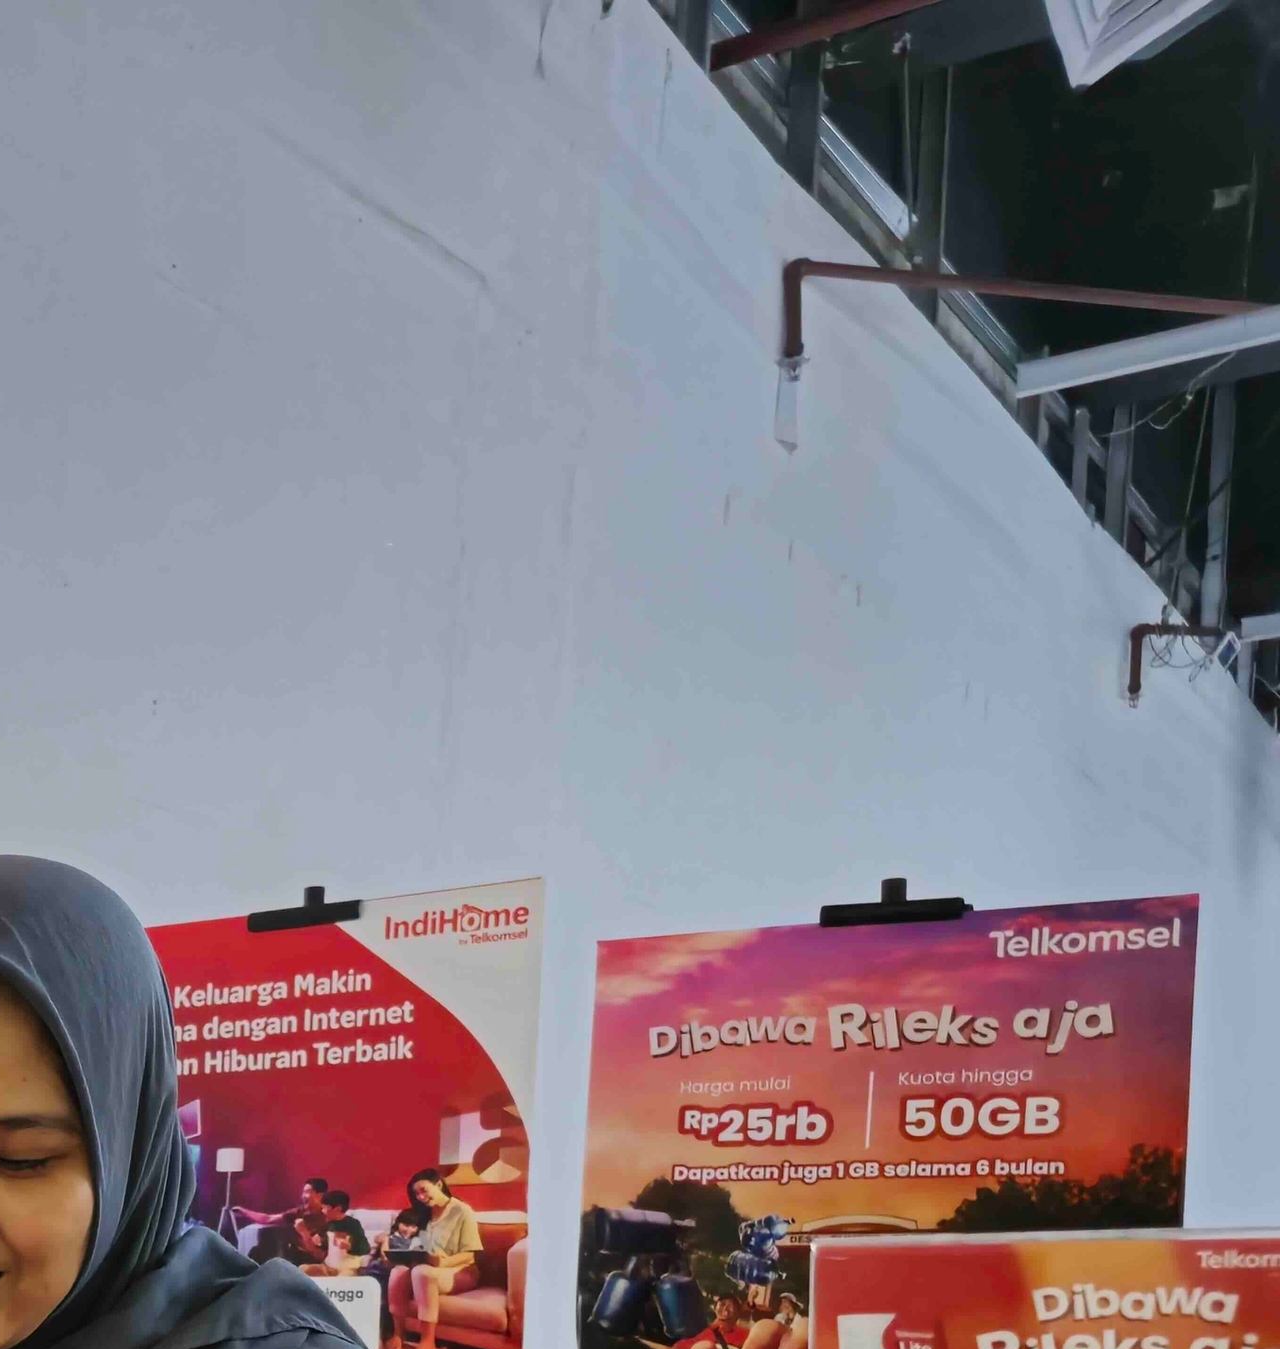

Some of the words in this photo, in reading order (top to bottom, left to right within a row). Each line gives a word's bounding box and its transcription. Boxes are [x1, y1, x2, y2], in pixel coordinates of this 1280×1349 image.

[385, 905, 529, 939] IndiHome
[470, 929, 528, 945] Telkomsel
[989, 919, 1181, 958] Telkomsel
[174, 979, 288, 1009] Keluarga
[294, 970, 371, 997] Makin
[204, 1015, 297, 1039] dengan
[304, 1000, 414, 1031] Internet
[649, 1011, 815, 1057] Dibawa
[828, 1002, 999, 1050] Rileks
[1013, 1000, 1114, 1052] aja
[205, 1049, 306, 1073] Hiburan
[313, 1036, 413, 1066] Terbaik
[680, 1081, 733, 1096] Harga
[739, 1076, 791, 1092] mulai
[898, 1069, 955, 1085] Kuota
[961, 1068, 1032, 1084] hingga
[684, 1107, 827, 1142] Rp25rb
[904, 1098, 1061, 1135] 50GB
[674, 1165, 779, 1183] Dapatkan
[781, 1164, 833, 1181] juga
[836, 1164, 845, 1178] 1
[848, 1162, 879, 1178] GB
[884, 1161, 973, 1178] selama
[977, 1160, 990, 1177] 6
[993, 1158, 1064, 1177] bulan
[1033, 1284, 1239, 1326] Dibawa
